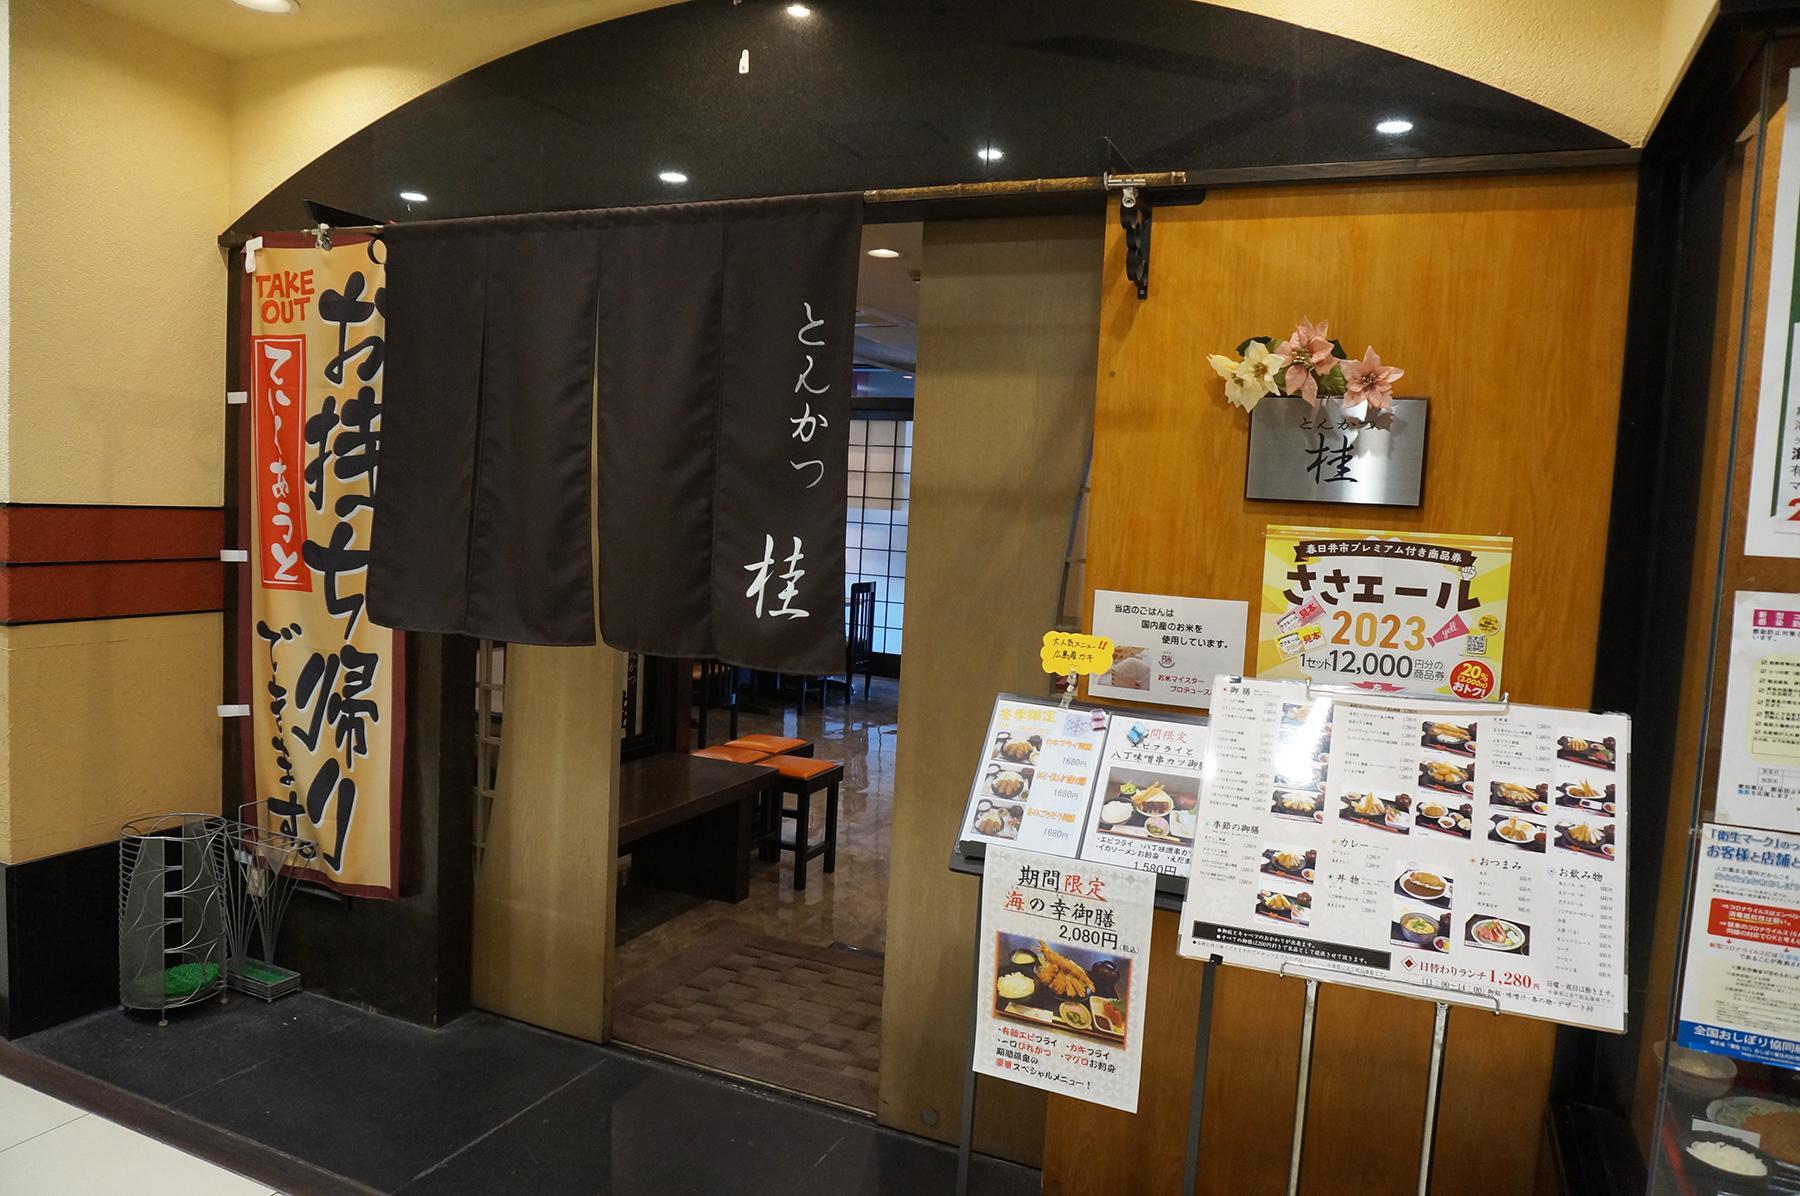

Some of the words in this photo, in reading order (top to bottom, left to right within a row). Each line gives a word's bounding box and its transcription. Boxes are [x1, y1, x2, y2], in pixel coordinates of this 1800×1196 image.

[255, 269, 315, 298] TAKE
[261, 297, 311, 324] OUT
[790, 302, 830, 488] とんかつ
[1300, 416, 1376, 431] とんかつ
[1305, 432, 1358, 485] 桂
[1306, 542, 1463, 563] 春日井市プレミアム付き商品券
[744, 533, 810, 620] 桂
[1283, 565, 1481, 612] ささエール
[1114, 604, 1175, 618] 当店のごはんは
[1141, 619, 1203, 634] 国内産のお米を
[1331, 610, 1426, 651] 2023
[1158, 674, 1205, 685] お米マイスター
[1170, 685, 1212, 696] プロデュース
[1145, 728, 1188, 744] 間限定
[1062, 756, 1087, 768] 1680円
[1053, 789, 1079, 800] 1680円
[1043, 828, 1069, 840] 1680円
[1213, 820, 1260, 835] 季節の御膳
[1339, 837, 1369, 848] カレー
[1479, 857, 1522, 871] おつまみ
[1559, 867, 1603, 883] お飲み物
[1017, 864, 1107, 903] 期間限定
[1004, 890, 1116, 929] 海の幸御膳
[1059, 924, 1118, 951] 2,080円
[1420, 961, 1487, 980] 日替わりランチ
